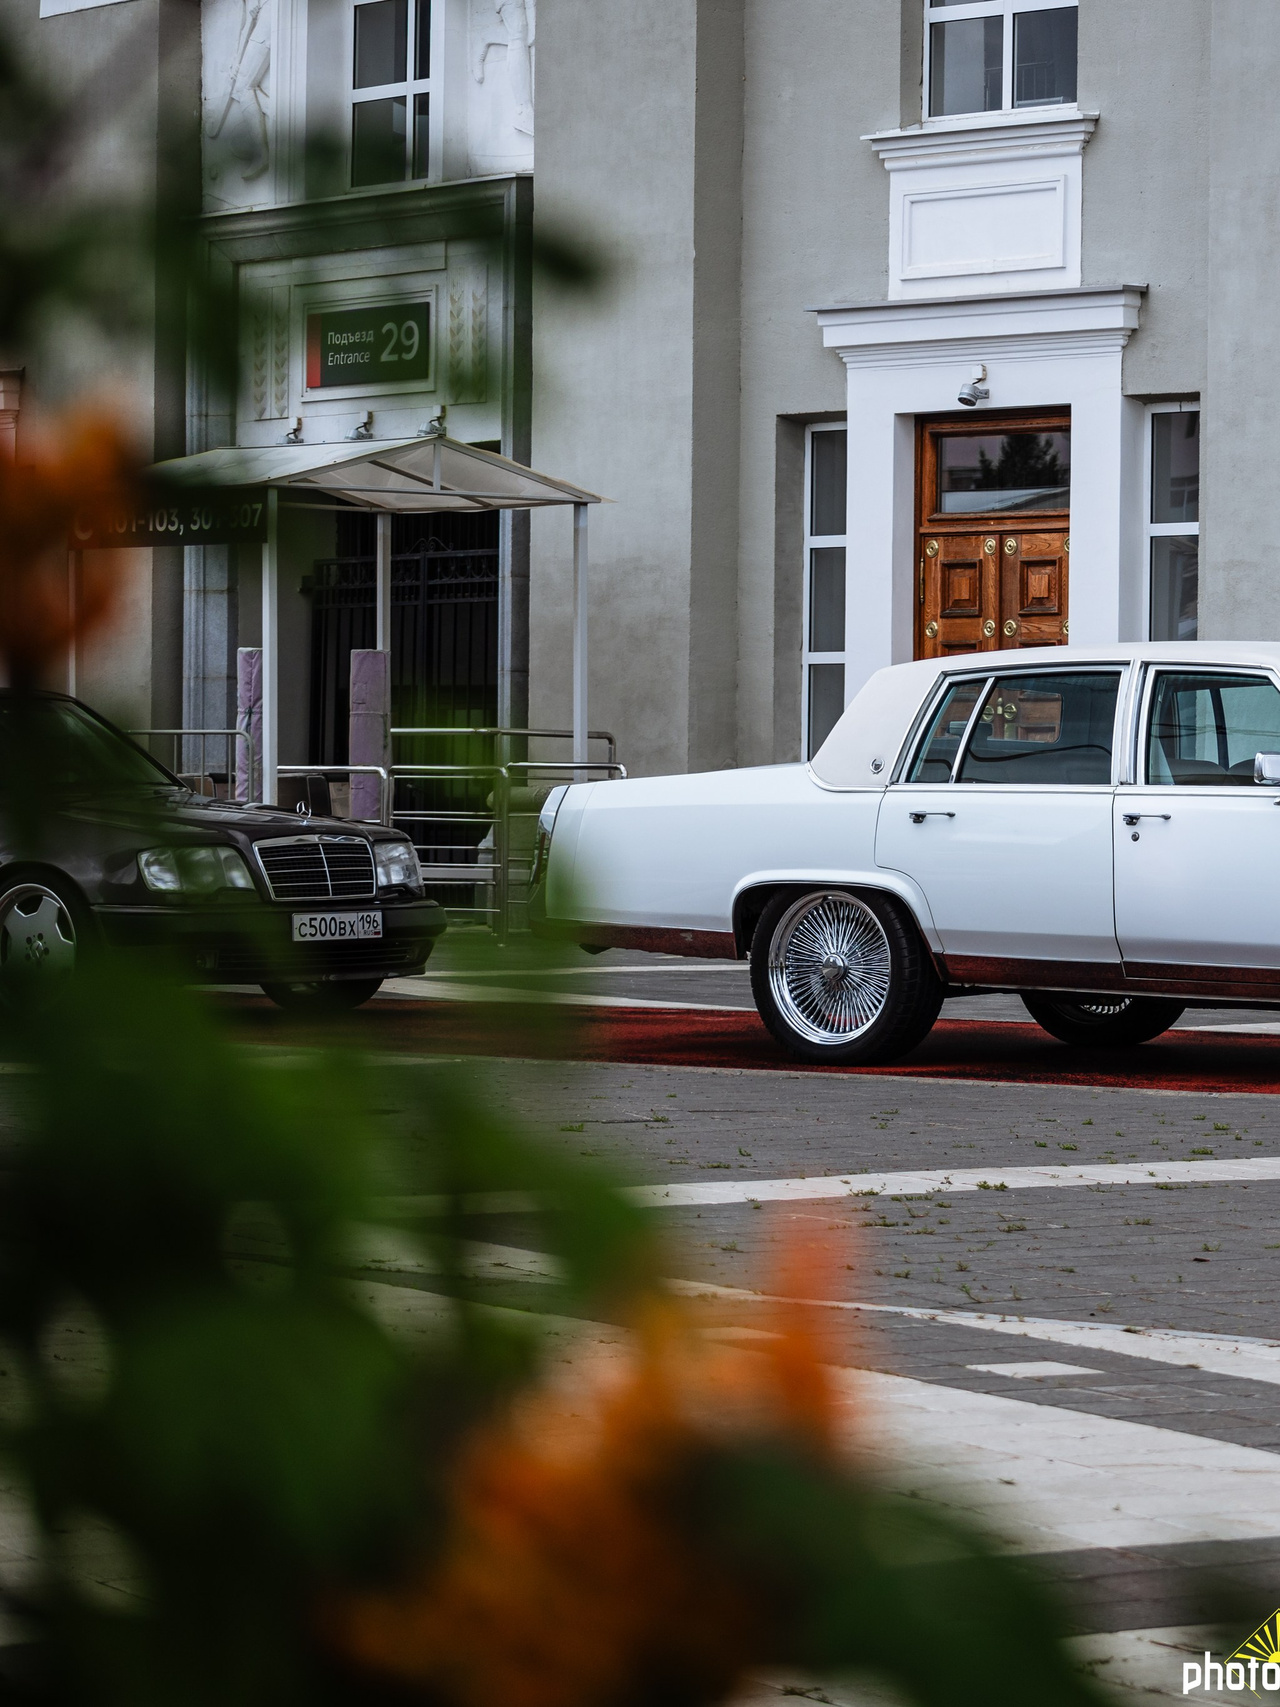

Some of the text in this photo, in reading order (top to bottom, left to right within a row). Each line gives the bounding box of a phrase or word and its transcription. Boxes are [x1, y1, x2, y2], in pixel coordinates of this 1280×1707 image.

[327, 330, 374, 346] Подъезд
[380, 320, 420, 362] 29
[327, 352, 371, 366] Entrance
[359, 914, 379, 930] 196
